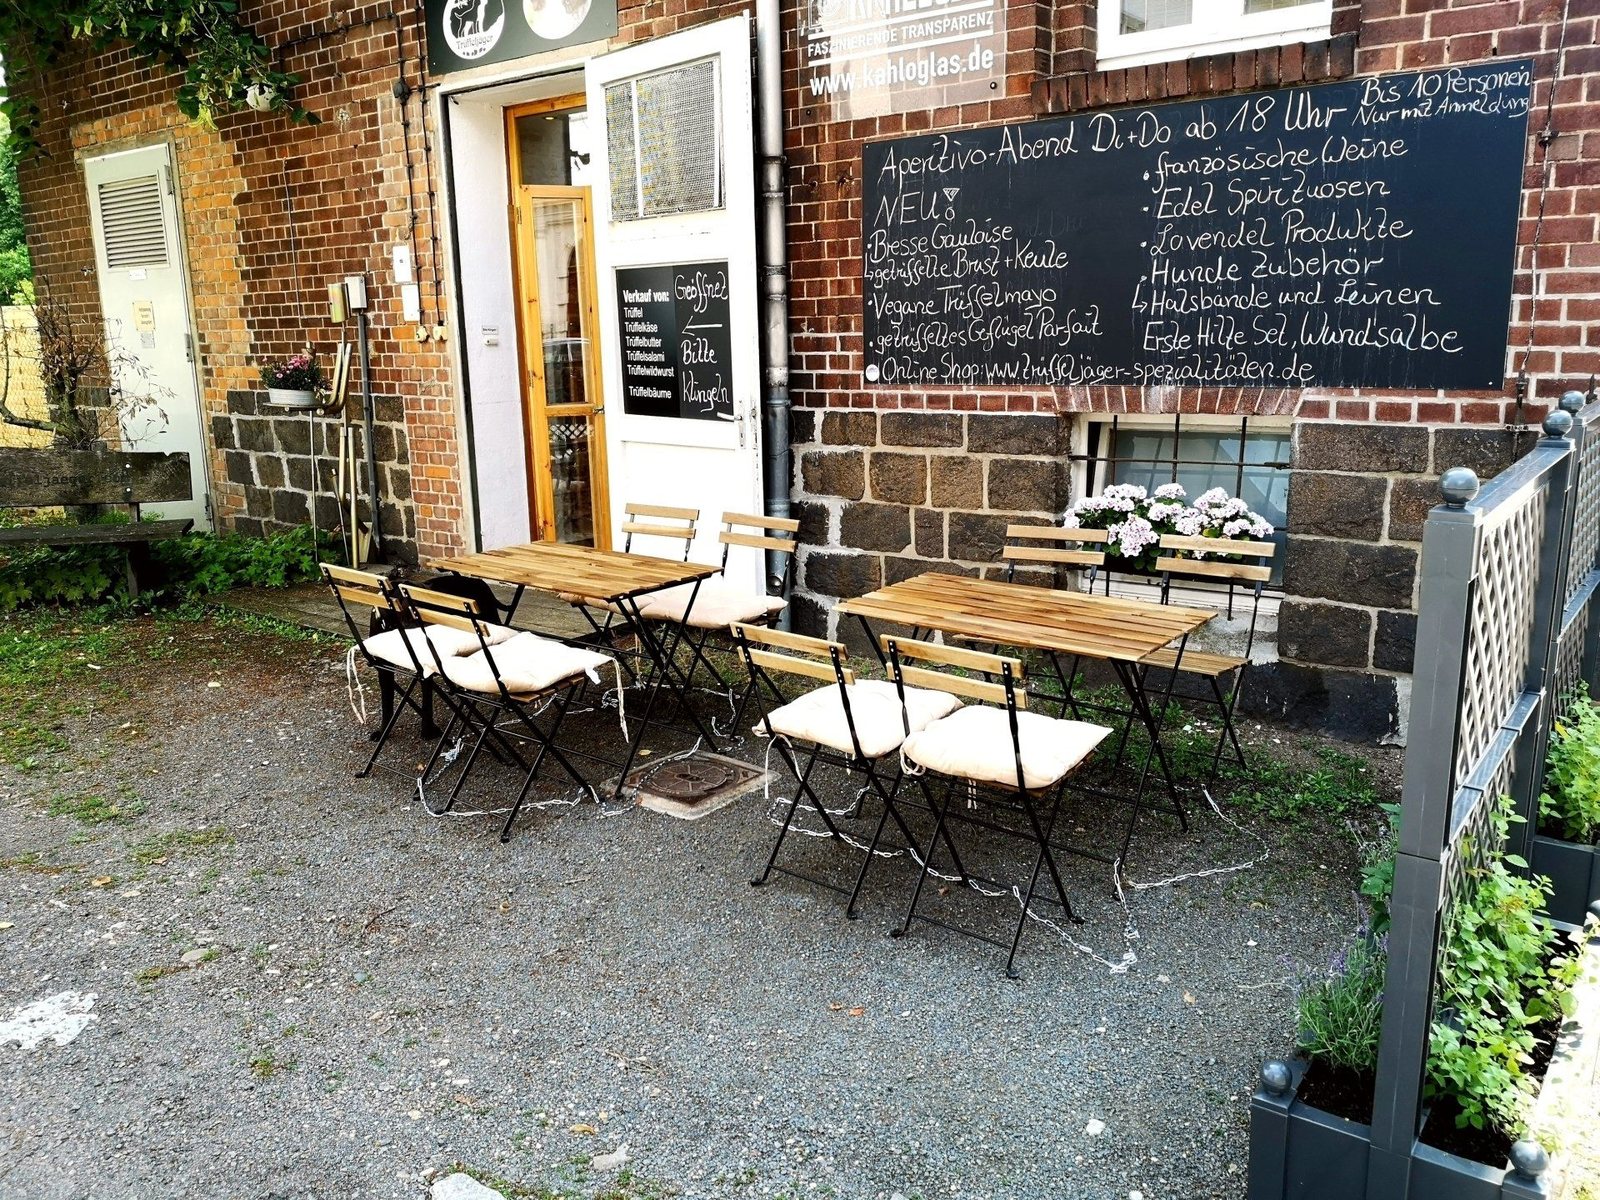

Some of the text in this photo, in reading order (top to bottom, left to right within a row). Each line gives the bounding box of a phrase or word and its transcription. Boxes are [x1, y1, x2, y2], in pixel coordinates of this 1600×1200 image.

[808, 10, 994, 57] FASZINIERENDE TRANSPARENZ
[810, 43, 994, 96] www.kahloglas.de
[1361, 66, 1530, 106] Bis 10 Personen
[1185, 105, 1217, 140] ab
[1226, 96, 1275, 133] 18
[1284, 90, 1347, 131] Uhr
[1352, 92, 1530, 126] Nur mit Anmeldung
[1320, 136, 1408, 165] Weine
[1157, 169, 1391, 220] Edel Spirituosen
[869, 229, 929, 263] Bresse
[932, 218, 1013, 249] Gauloise
[1281, 208, 1414, 246] Produkte
[952, 246, 1000, 277] Brust
[1151, 247, 1384, 285] Hunde Zubehör
[622, 289, 670, 303] Verkauf von:
[674, 271, 729, 313] Geöffnet
[873, 292, 939, 324] Vegane
[1151, 278, 1441, 316] Halsbände und Leinen
[623, 307, 643, 318] Trüffel
[624, 321, 658, 333] Trüffelkäse
[968, 312, 1034, 351] Geflügel
[1035, 305, 1103, 346] Parfait
[625, 336, 662, 347] Trüffelbutter
[681, 338, 717, 365] Bitte
[1143, 320, 1192, 353] Erste
[1197, 314, 1248, 350] Hilfe
[626, 350, 665, 362] Trüffelsalami
[627, 364, 674, 377] Trüffelwildwurst
[881, 355, 938, 382] Online
[628, 386, 672, 399] Trüffelbäume
[682, 370, 730, 413] Klingeln
